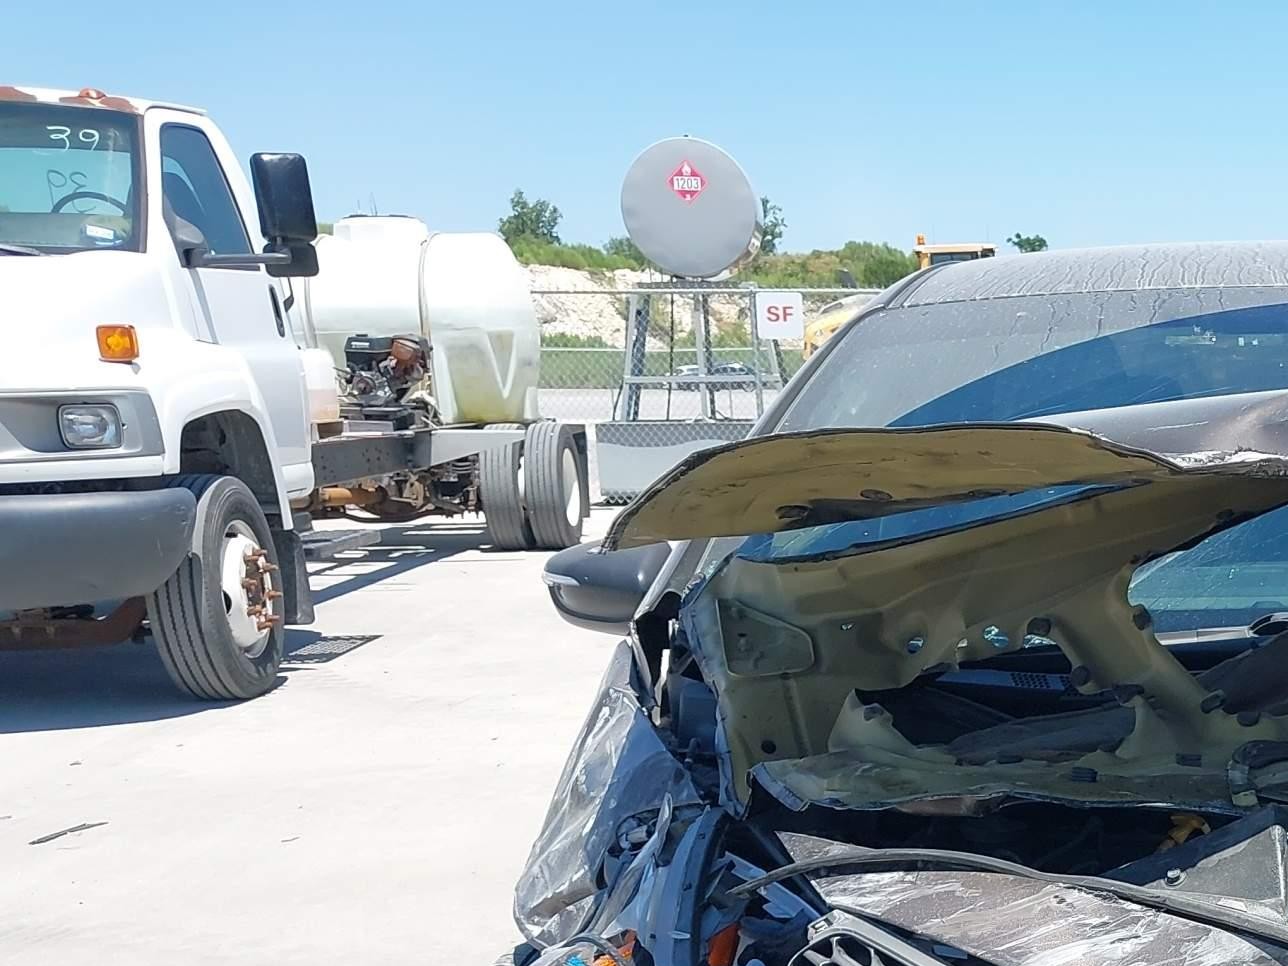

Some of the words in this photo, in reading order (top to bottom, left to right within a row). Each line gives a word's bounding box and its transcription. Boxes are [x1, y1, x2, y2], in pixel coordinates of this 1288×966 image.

[46, 125, 99, 152] 39
[675, 177, 700, 190] 1203
[766, 305, 794, 322] SF
